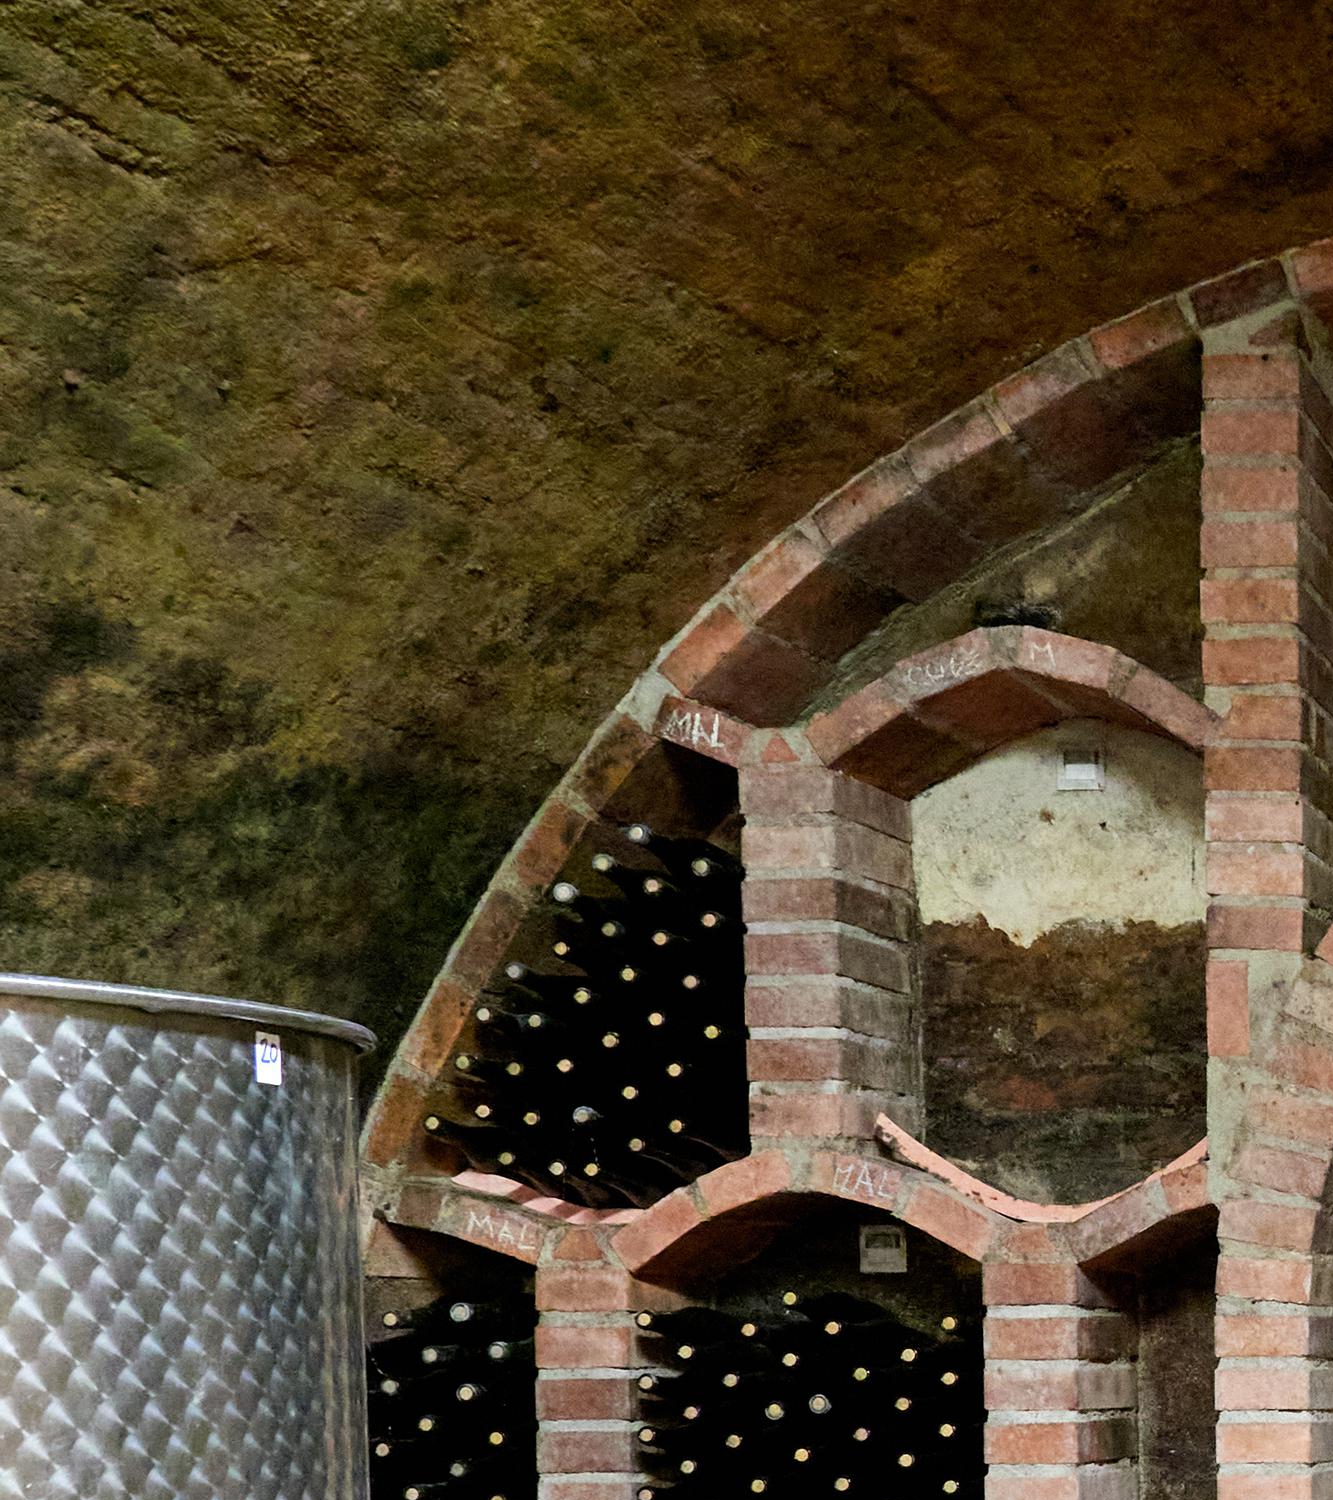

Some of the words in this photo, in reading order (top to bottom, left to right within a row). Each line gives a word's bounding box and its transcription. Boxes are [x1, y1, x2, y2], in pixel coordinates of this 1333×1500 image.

[1030, 642, 1057, 669] M
[661, 708, 725, 748] MAL
[260, 1038, 279, 1063] 20
[833, 1161, 894, 1200] MAL
[465, 1210, 537, 1250] MAL
